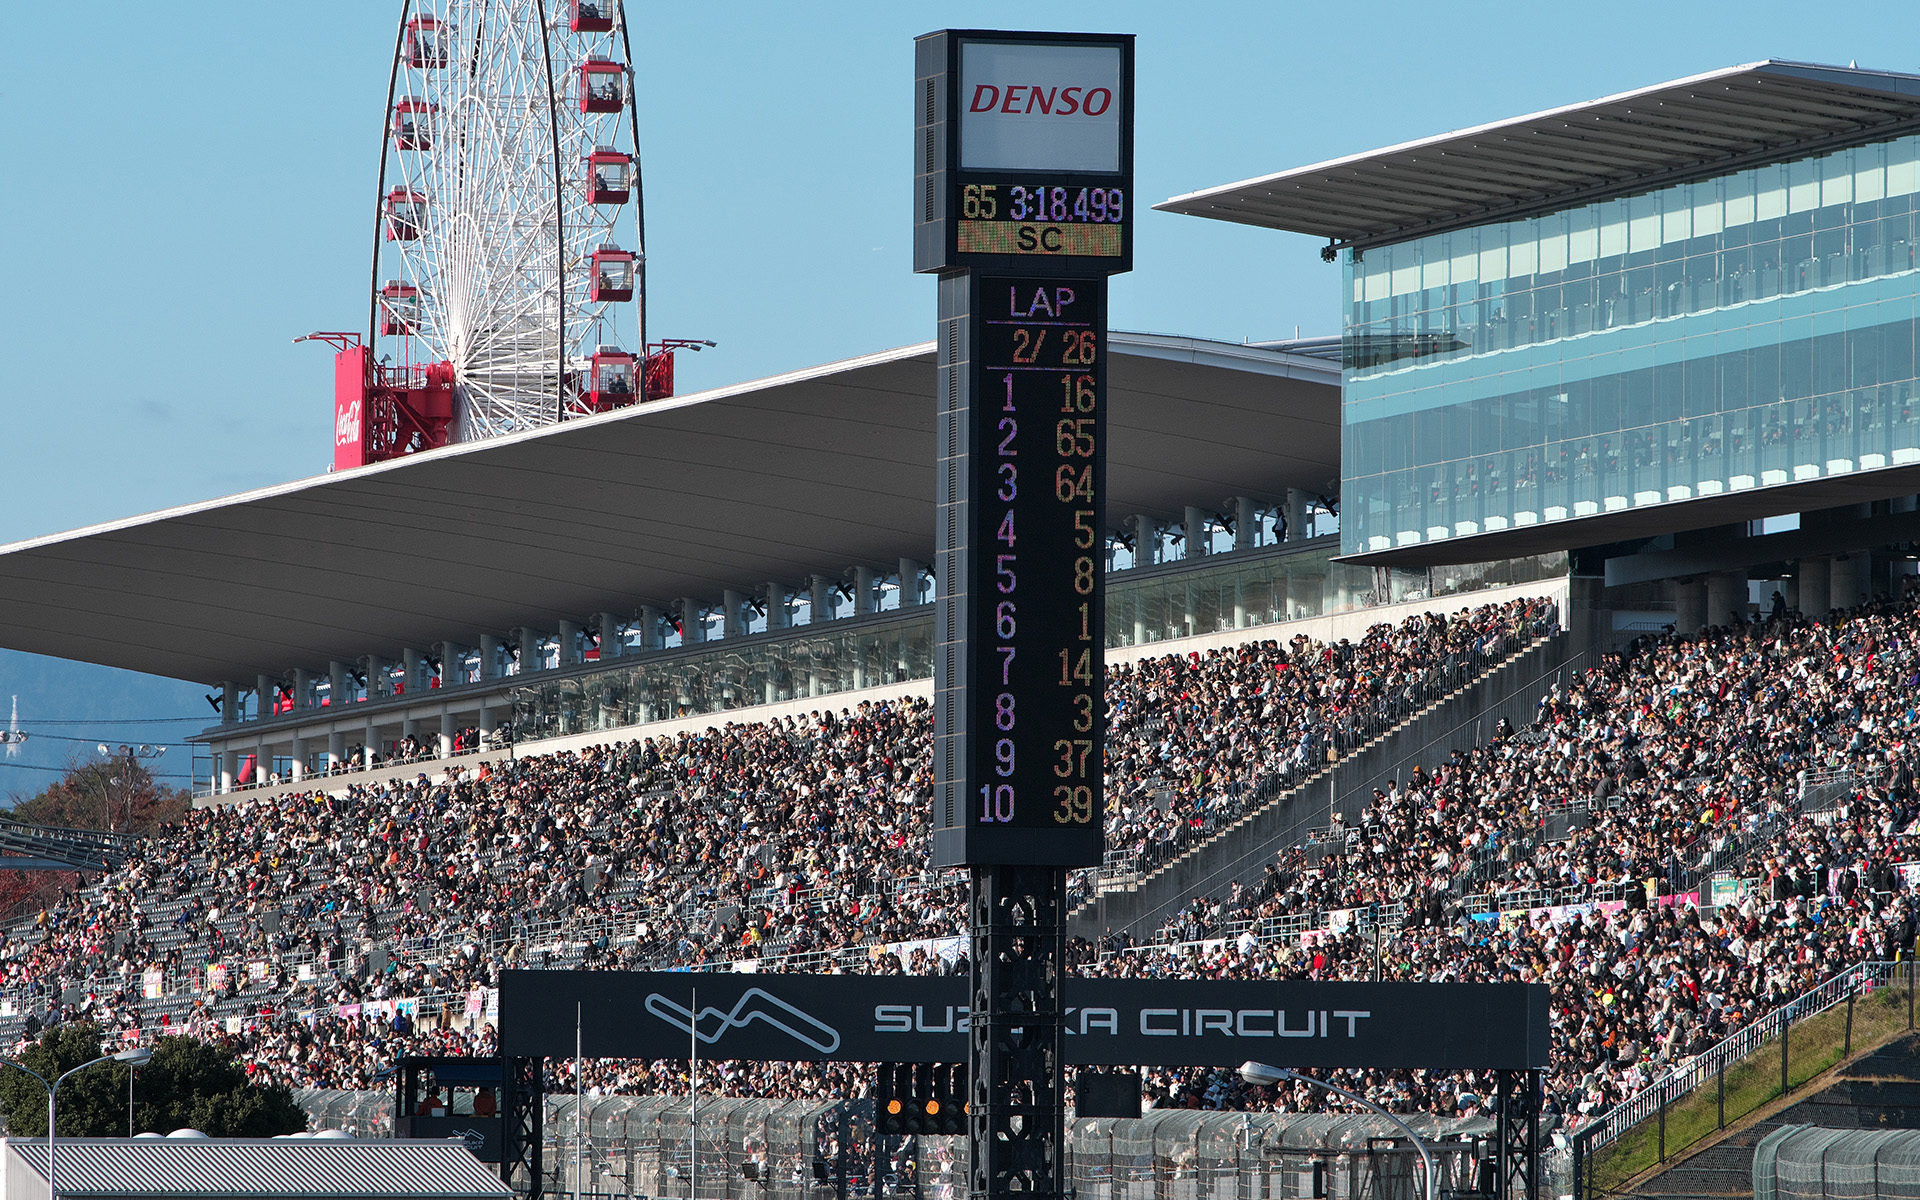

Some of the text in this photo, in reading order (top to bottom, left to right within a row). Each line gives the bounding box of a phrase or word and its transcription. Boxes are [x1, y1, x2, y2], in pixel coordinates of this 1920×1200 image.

[969, 85, 1112, 116] DENSO
[964, 185, 1123, 222] 65 3:18.499
[1017, 226, 1063, 251] SC
[1011, 287, 1074, 317] LAP
[1063, 330, 1095, 364] 26
[1003, 373, 1095, 412] 1 16
[999, 418, 1094, 457] 2 65
[998, 463, 1094, 502] 3 64
[998, 509, 1094, 548] 4 5
[997, 555, 1093, 594] 5 8
[997, 602, 1091, 640] 6 1
[997, 647, 1092, 686] 7 14
[996, 693, 1092, 732] 8 3
[996, 739, 1092, 777] 9 37
[980, 784, 1092, 823] 10 39
[1139, 1008, 1371, 1038] CIRCUIT
